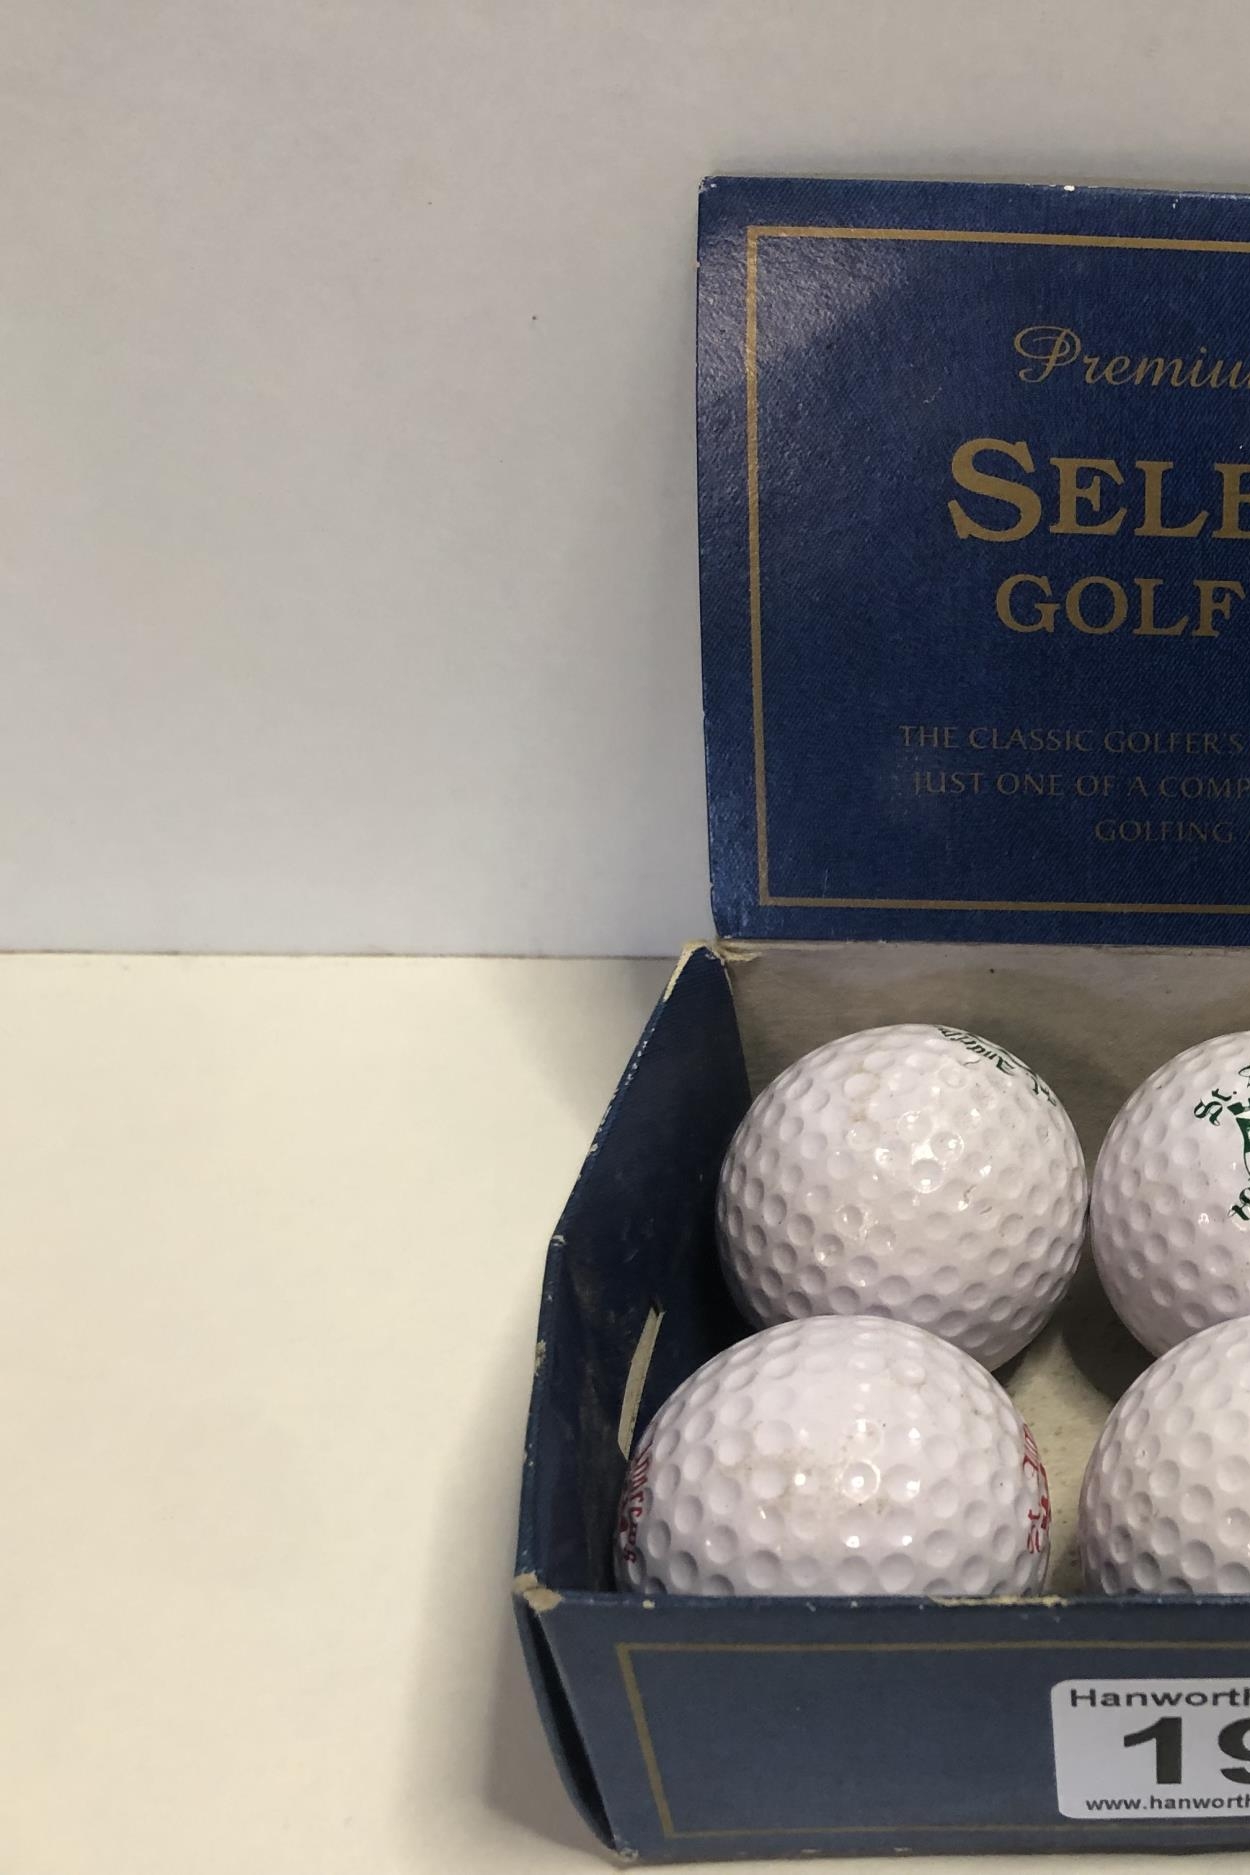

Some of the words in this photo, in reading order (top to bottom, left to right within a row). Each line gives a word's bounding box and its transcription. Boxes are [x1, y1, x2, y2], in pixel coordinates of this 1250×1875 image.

[995, 573, 1246, 640] GOLF
[899, 725, 960, 749] THE
[967, 726, 1093, 751] CLASSIC
[1103, 730, 1246, 754] GOLFER'S
[912, 771, 984, 796] JUST
[996, 772, 1064, 797] ONE
[1074, 774, 1116, 798] OF
[1127, 776, 1149, 798] A
[1095, 818, 1235, 844] GOLFING
[1193, 1087, 1238, 1127] St.
